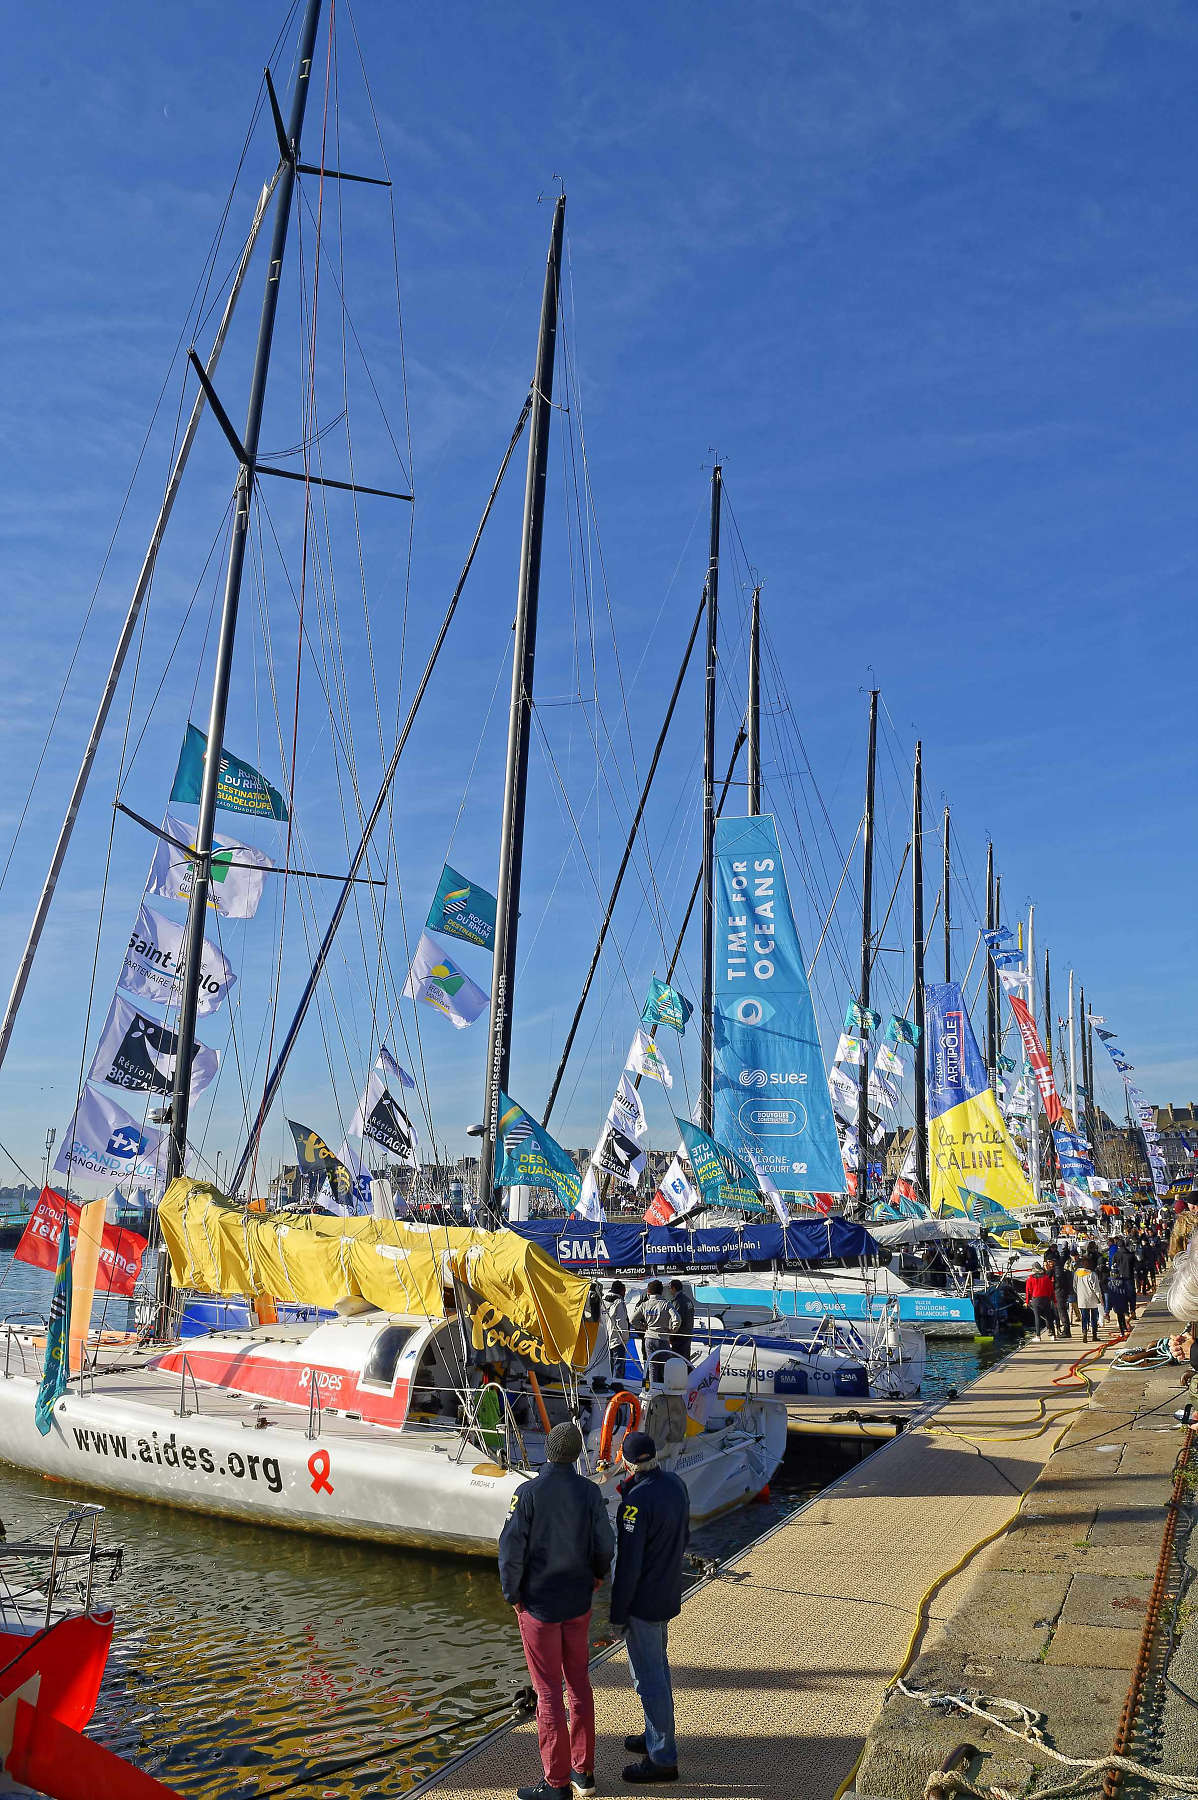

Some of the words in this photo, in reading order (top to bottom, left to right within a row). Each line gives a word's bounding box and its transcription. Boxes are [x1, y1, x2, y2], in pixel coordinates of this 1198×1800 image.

[225, 774, 240, 787] DU
[732, 860, 748, 902] FOR
[456, 913, 469, 926] DU
[468, 921, 491, 939] RHUM
[469, 913, 493, 933] ROUTE
[753, 858, 775, 980] OCEANS
[727, 915, 747, 981] TIME
[123, 957, 170, 988] PARTENAIRE
[117, 1056, 152, 1080] Région
[65, 1152, 106, 1175] BANQUE
[72, 1141, 120, 1170] GRAND
[792, 1162, 808, 1174] 92
[558, 1239, 610, 1260] SMA
[646, 1244, 695, 1254] Ensemble,
[697, 1243, 719, 1253] allons
[722, 1242, 739, 1253] plus
[73, 1427, 284, 1494] www.aides.org
[623, 1505, 639, 1520] 22
